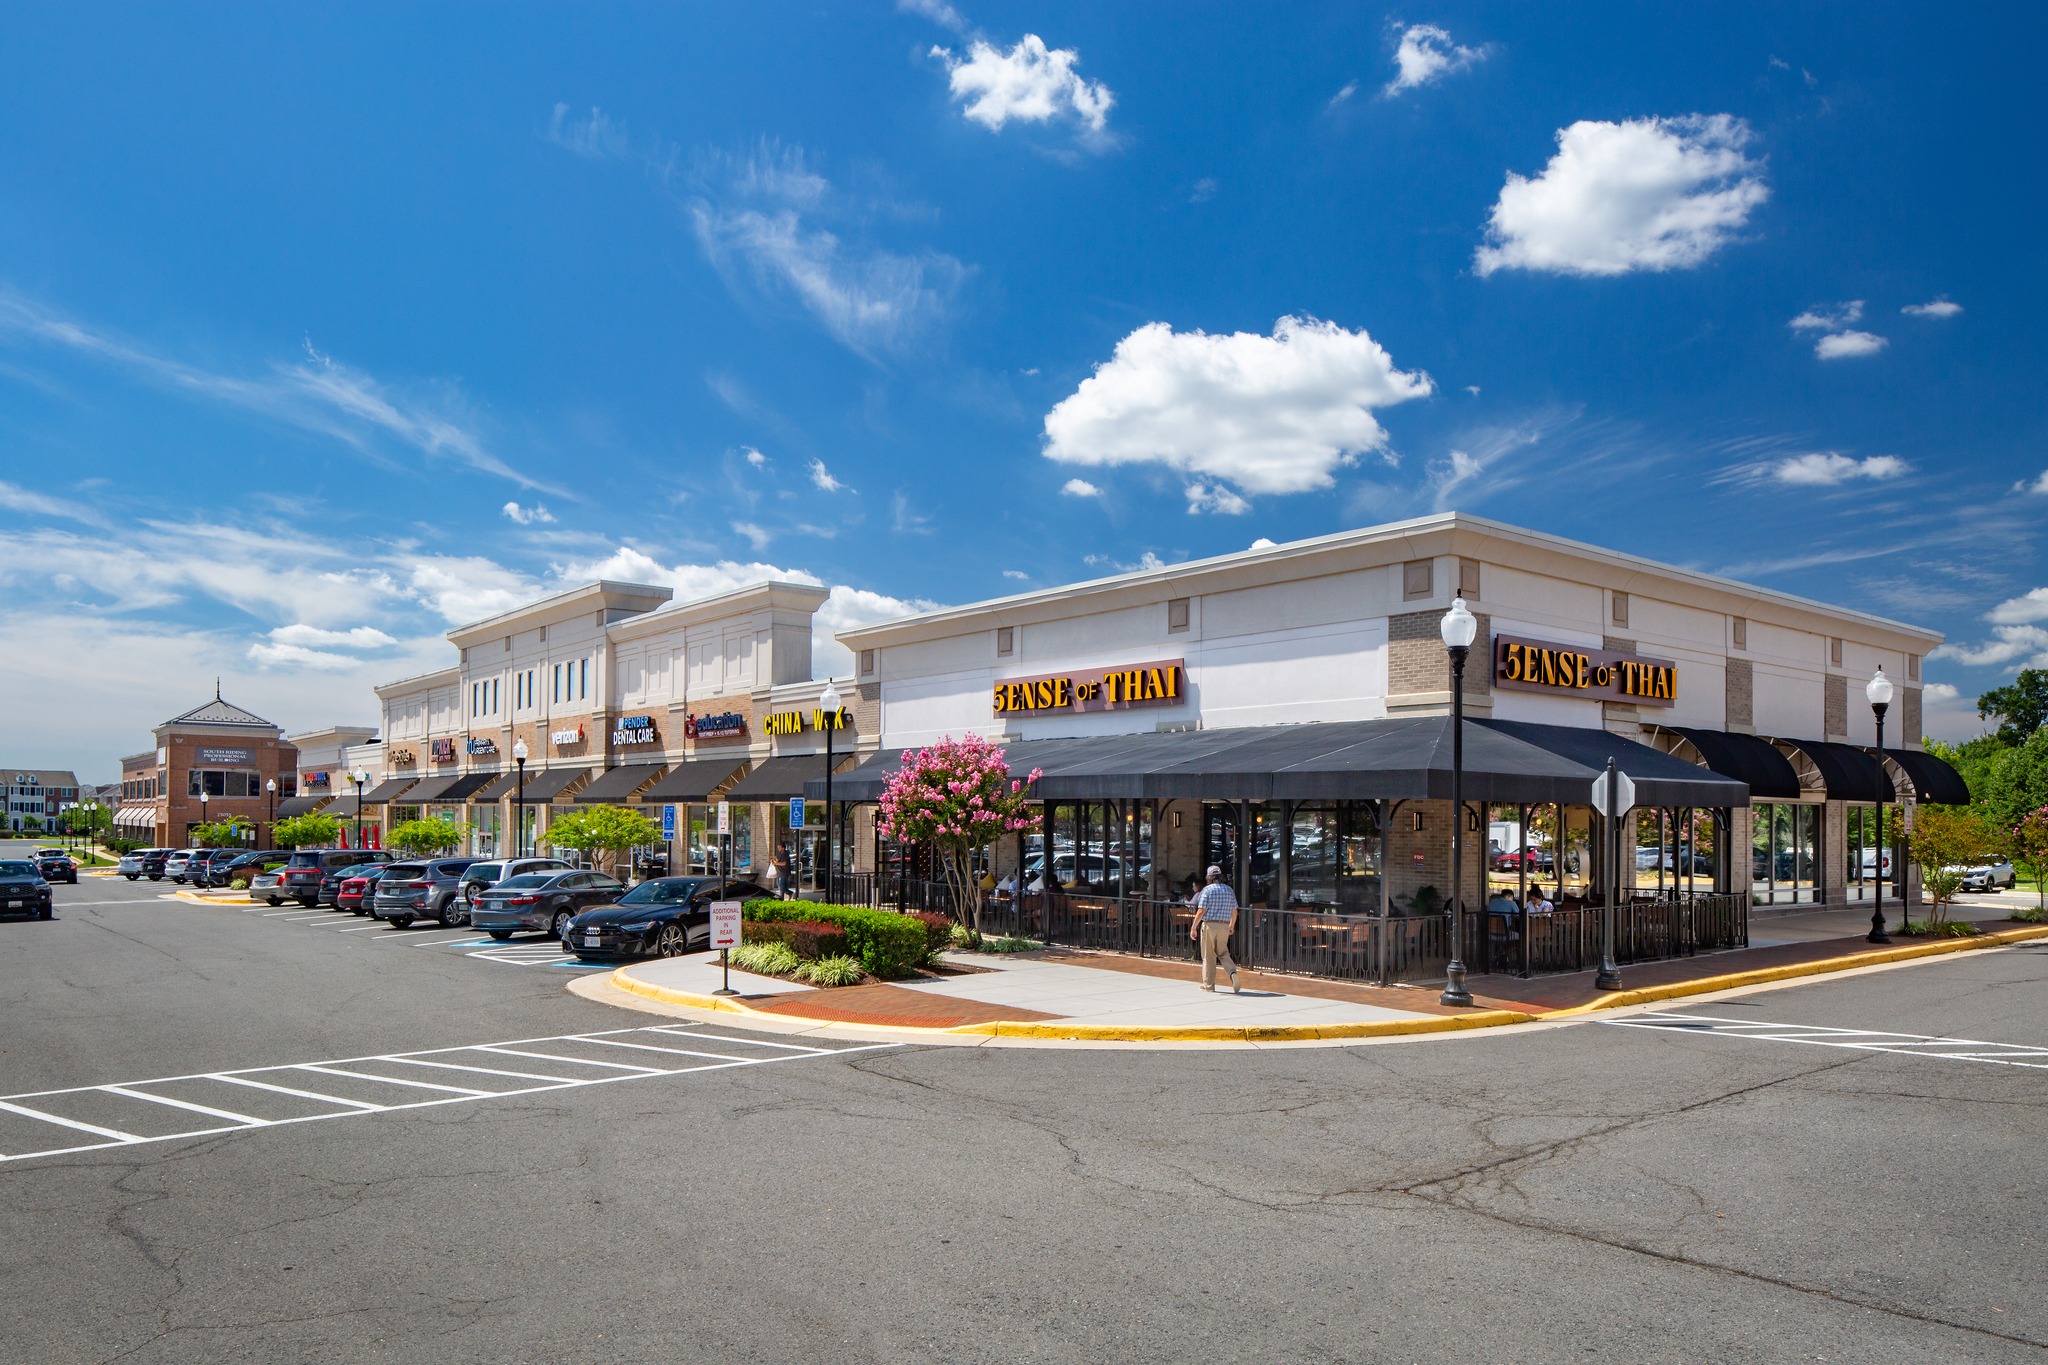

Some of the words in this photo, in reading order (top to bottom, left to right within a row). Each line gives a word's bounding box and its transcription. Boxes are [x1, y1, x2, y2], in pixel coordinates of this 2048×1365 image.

[1505, 643, 1589, 689] 5ENSE
[1597, 666, 1617, 687] OF
[1622, 660, 1678, 700] THAI
[992, 677, 1069, 712] 5ENSE
[1076, 682, 1097, 701] OF
[1104, 666, 1177, 702] THAI
[624, 716, 649, 729] PENDER
[697, 712, 742, 731] education
[763, 711, 802, 736] CHINA
[813, 706, 844, 731] WK
[551, 728, 579, 745] verizon
[613, 729, 637, 745] DENTAL
[637, 728, 654, 743] CARE
